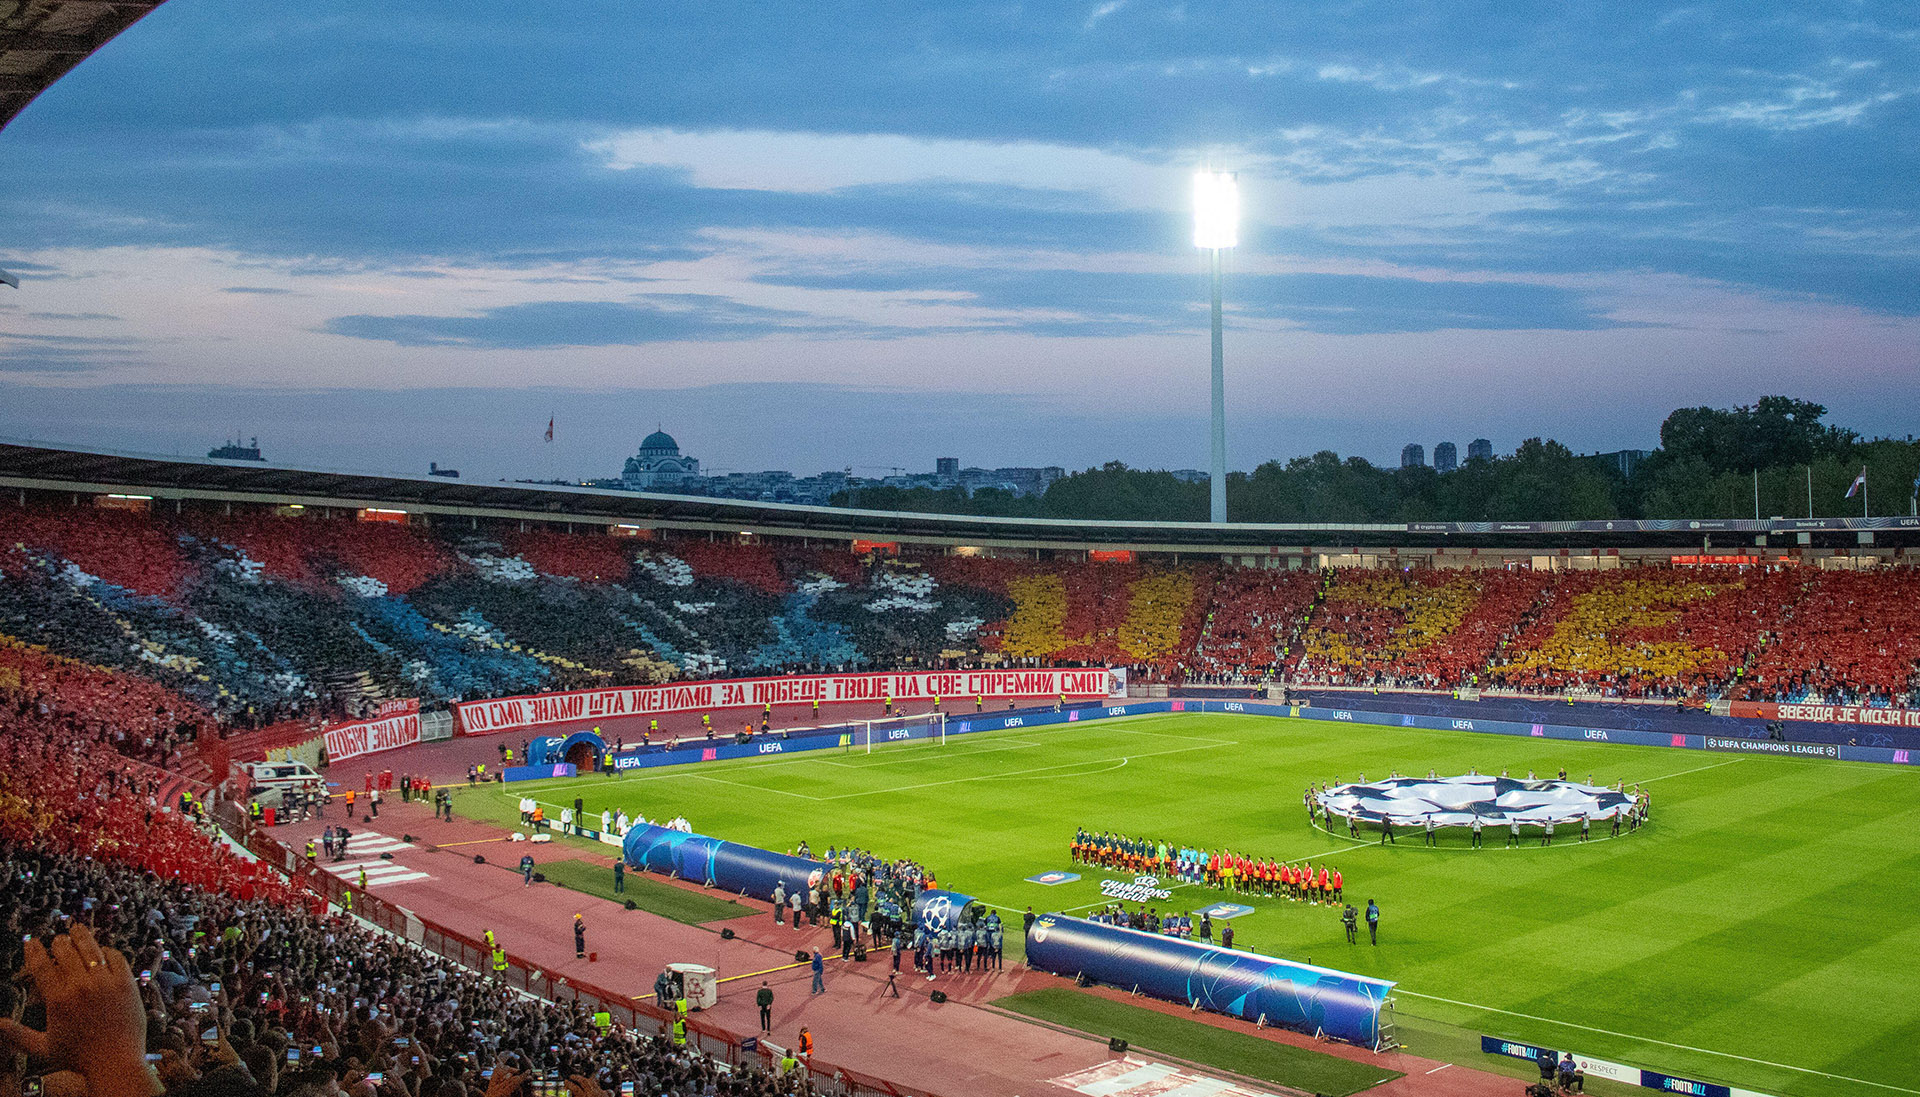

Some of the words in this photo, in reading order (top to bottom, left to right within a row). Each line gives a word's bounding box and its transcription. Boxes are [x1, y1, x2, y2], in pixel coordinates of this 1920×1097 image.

[464, 706, 487, 729] КО
[528, 695, 583, 723] ЗНАМО
[589, 691, 625, 715] ШТА
[721, 684, 745, 705] ЗА
[752, 679, 826, 703] ПОБЕДЕ
[833, 678, 889, 699] ТВОЈЕ
[895, 676, 920, 697] НА
[926, 675, 961, 695] СВЕ
[968, 673, 1054, 694] СПРЕМНИ
[1060, 672, 1103, 692] СМО!
[1108, 706, 1126, 716] UEFA
[1224, 702, 1244, 712] UEFA
[1333, 711, 1353, 721] UEFA
[1777, 705, 1834, 722] ЗВЕЗДА
[1004, 717, 1023, 727] UEFA
[1452, 719, 1473, 730] UEFA
[888, 729, 910, 739] UEFA
[1584, 729, 1608, 740] UEFA
[759, 743, 782, 753] UEFA
[1717, 740, 1739, 748] UEFA
[1740, 741, 1789, 752] CHAMPIONS
[1792, 745, 1824, 754] LEAGUE
[614, 757, 640, 769] UEFA
[1100, 879, 1172, 899] CHAMPIONS
[1101, 887, 1150, 903] LEAGUE
[1501, 1042, 1538, 1060] #FOOTBALL
[1589, 1063, 1618, 1075] RESPECT
[1664, 1077, 1706, 1096] #FOOTBALL
